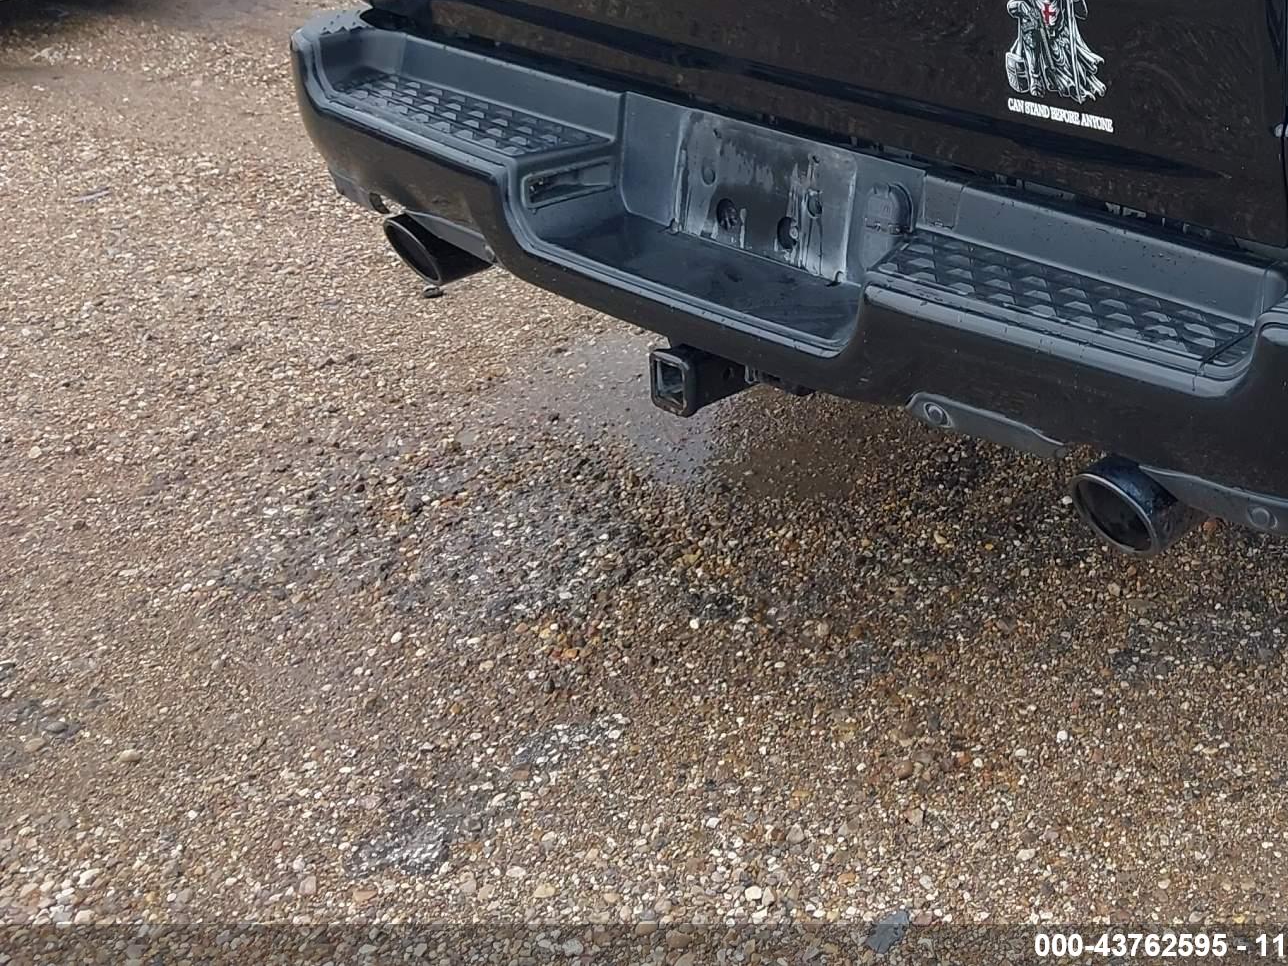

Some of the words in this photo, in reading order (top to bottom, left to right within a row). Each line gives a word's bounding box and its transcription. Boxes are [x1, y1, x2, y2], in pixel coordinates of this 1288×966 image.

[1007, 97, 1024, 114] CAN
[1024, 101, 1050, 119] STAND
[1050, 106, 1080, 125] BEFORE
[1081, 113, 1114, 133] ANYONE
